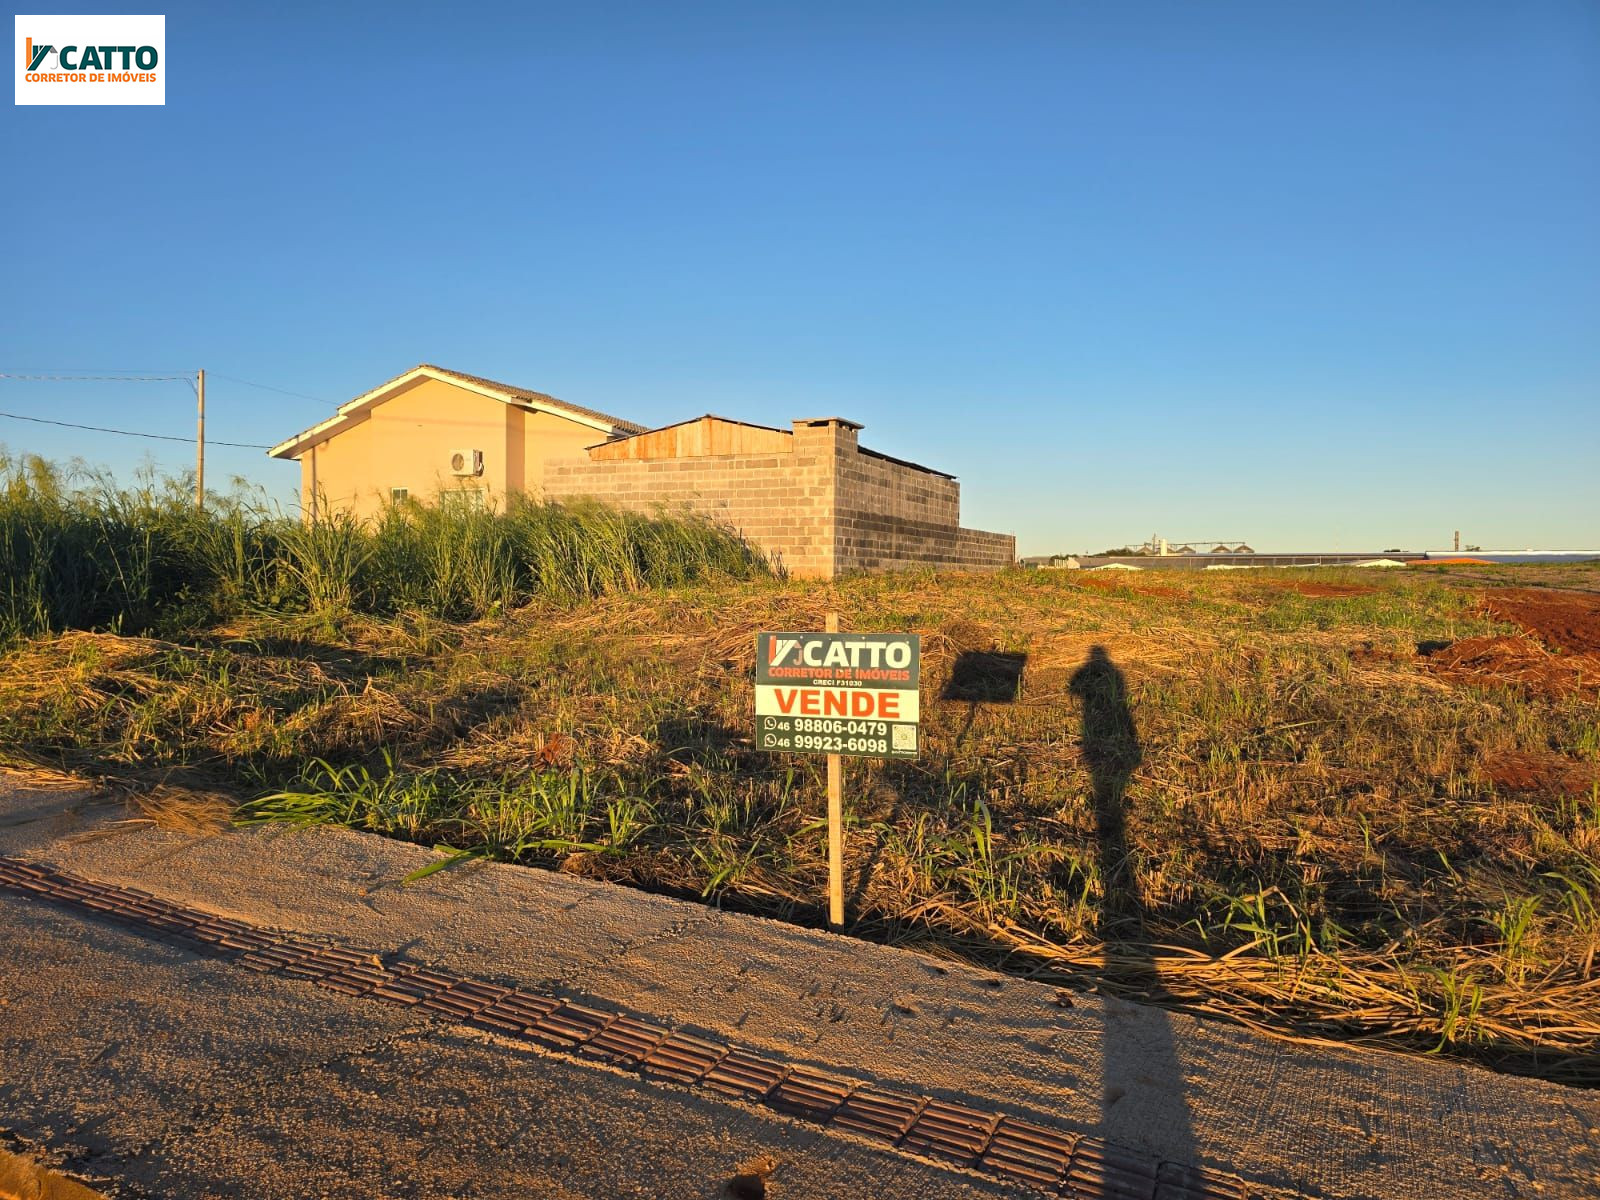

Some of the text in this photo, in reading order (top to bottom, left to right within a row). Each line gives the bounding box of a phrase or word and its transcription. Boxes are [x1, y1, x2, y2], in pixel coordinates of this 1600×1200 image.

[803, 641, 911, 668] CATTO
[768, 667, 910, 680] CORRETOR DE IMÓVEIS
[774, 689, 900, 718] VENDE
[777, 719, 887, 735] 46 98806-0479
[777, 735, 887, 752] 46 99923-6098
